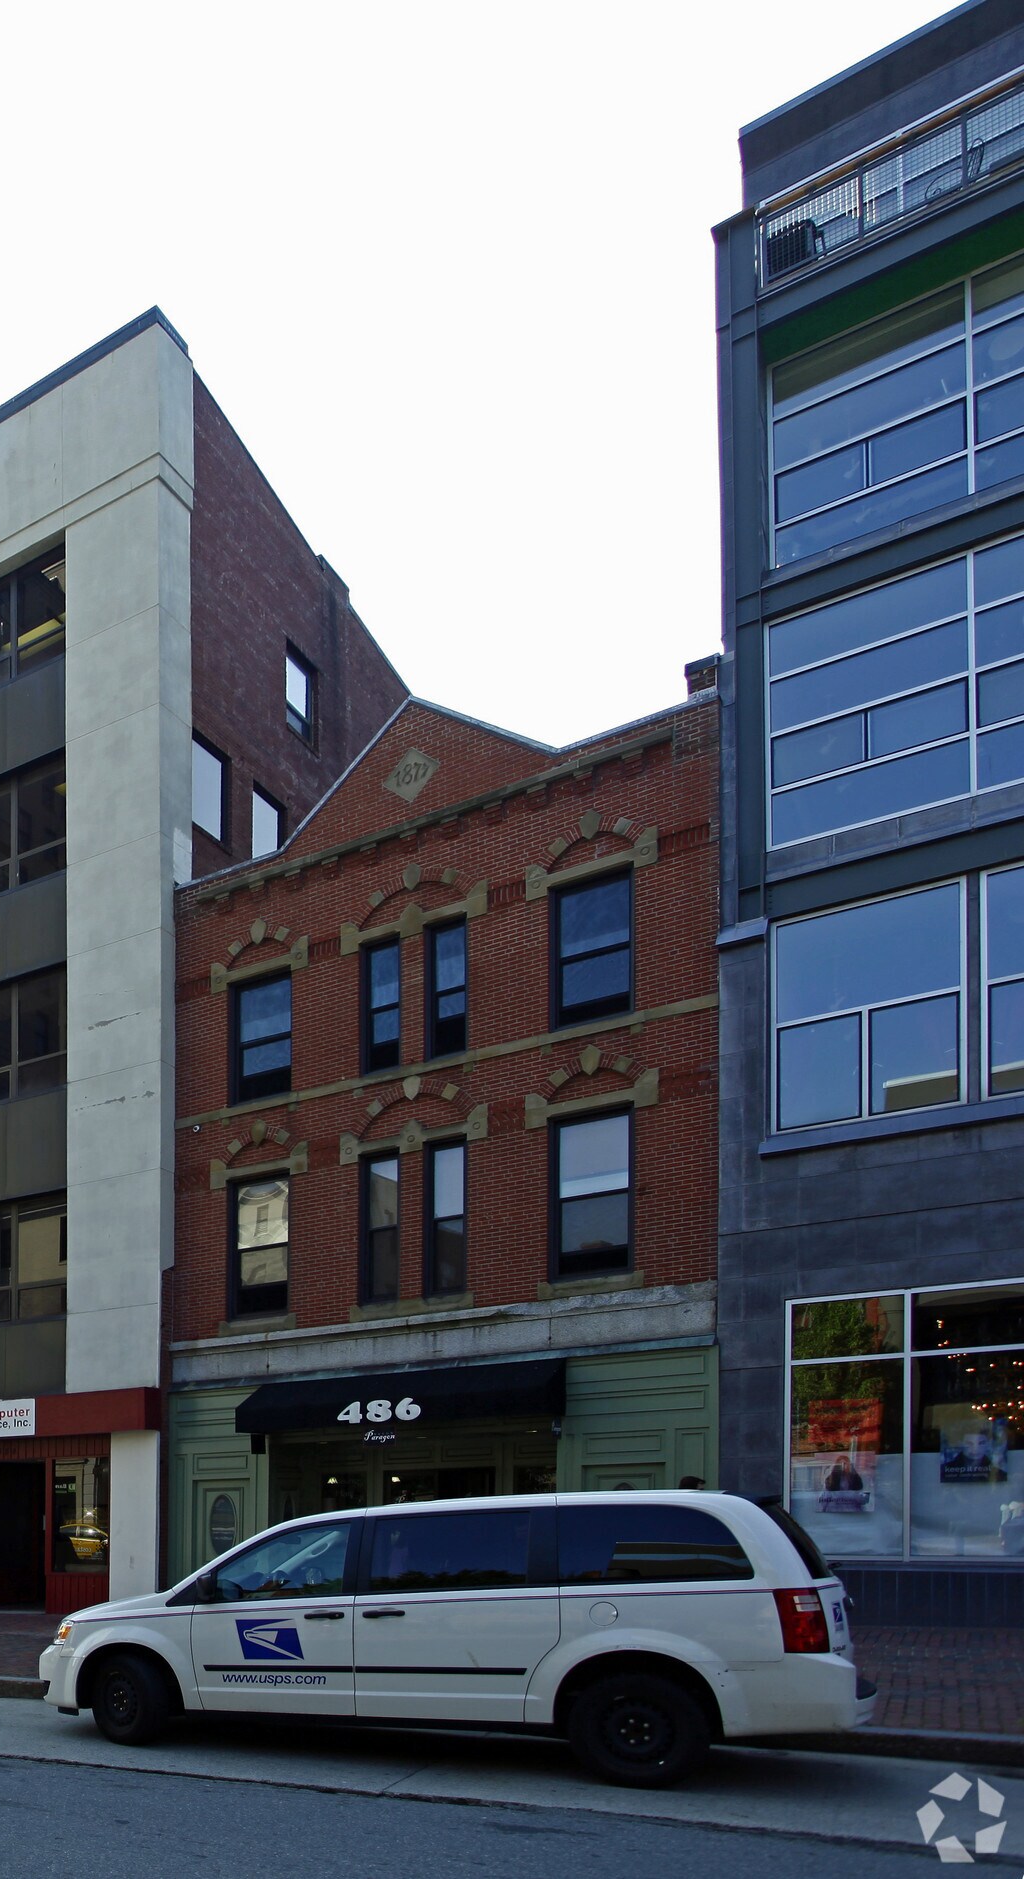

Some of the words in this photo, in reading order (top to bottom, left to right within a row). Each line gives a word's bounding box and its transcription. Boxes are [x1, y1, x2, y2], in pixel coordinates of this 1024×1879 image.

[394, 762, 430, 787] 1877
[337, 1397, 421, 1424] 486
[13, 1418, 32, 1428] Inc.
[364, 1429, 395, 1442] Paragon
[945, 1465, 966, 1473] keep
[222, 1673, 327, 1687] www.usps.com
